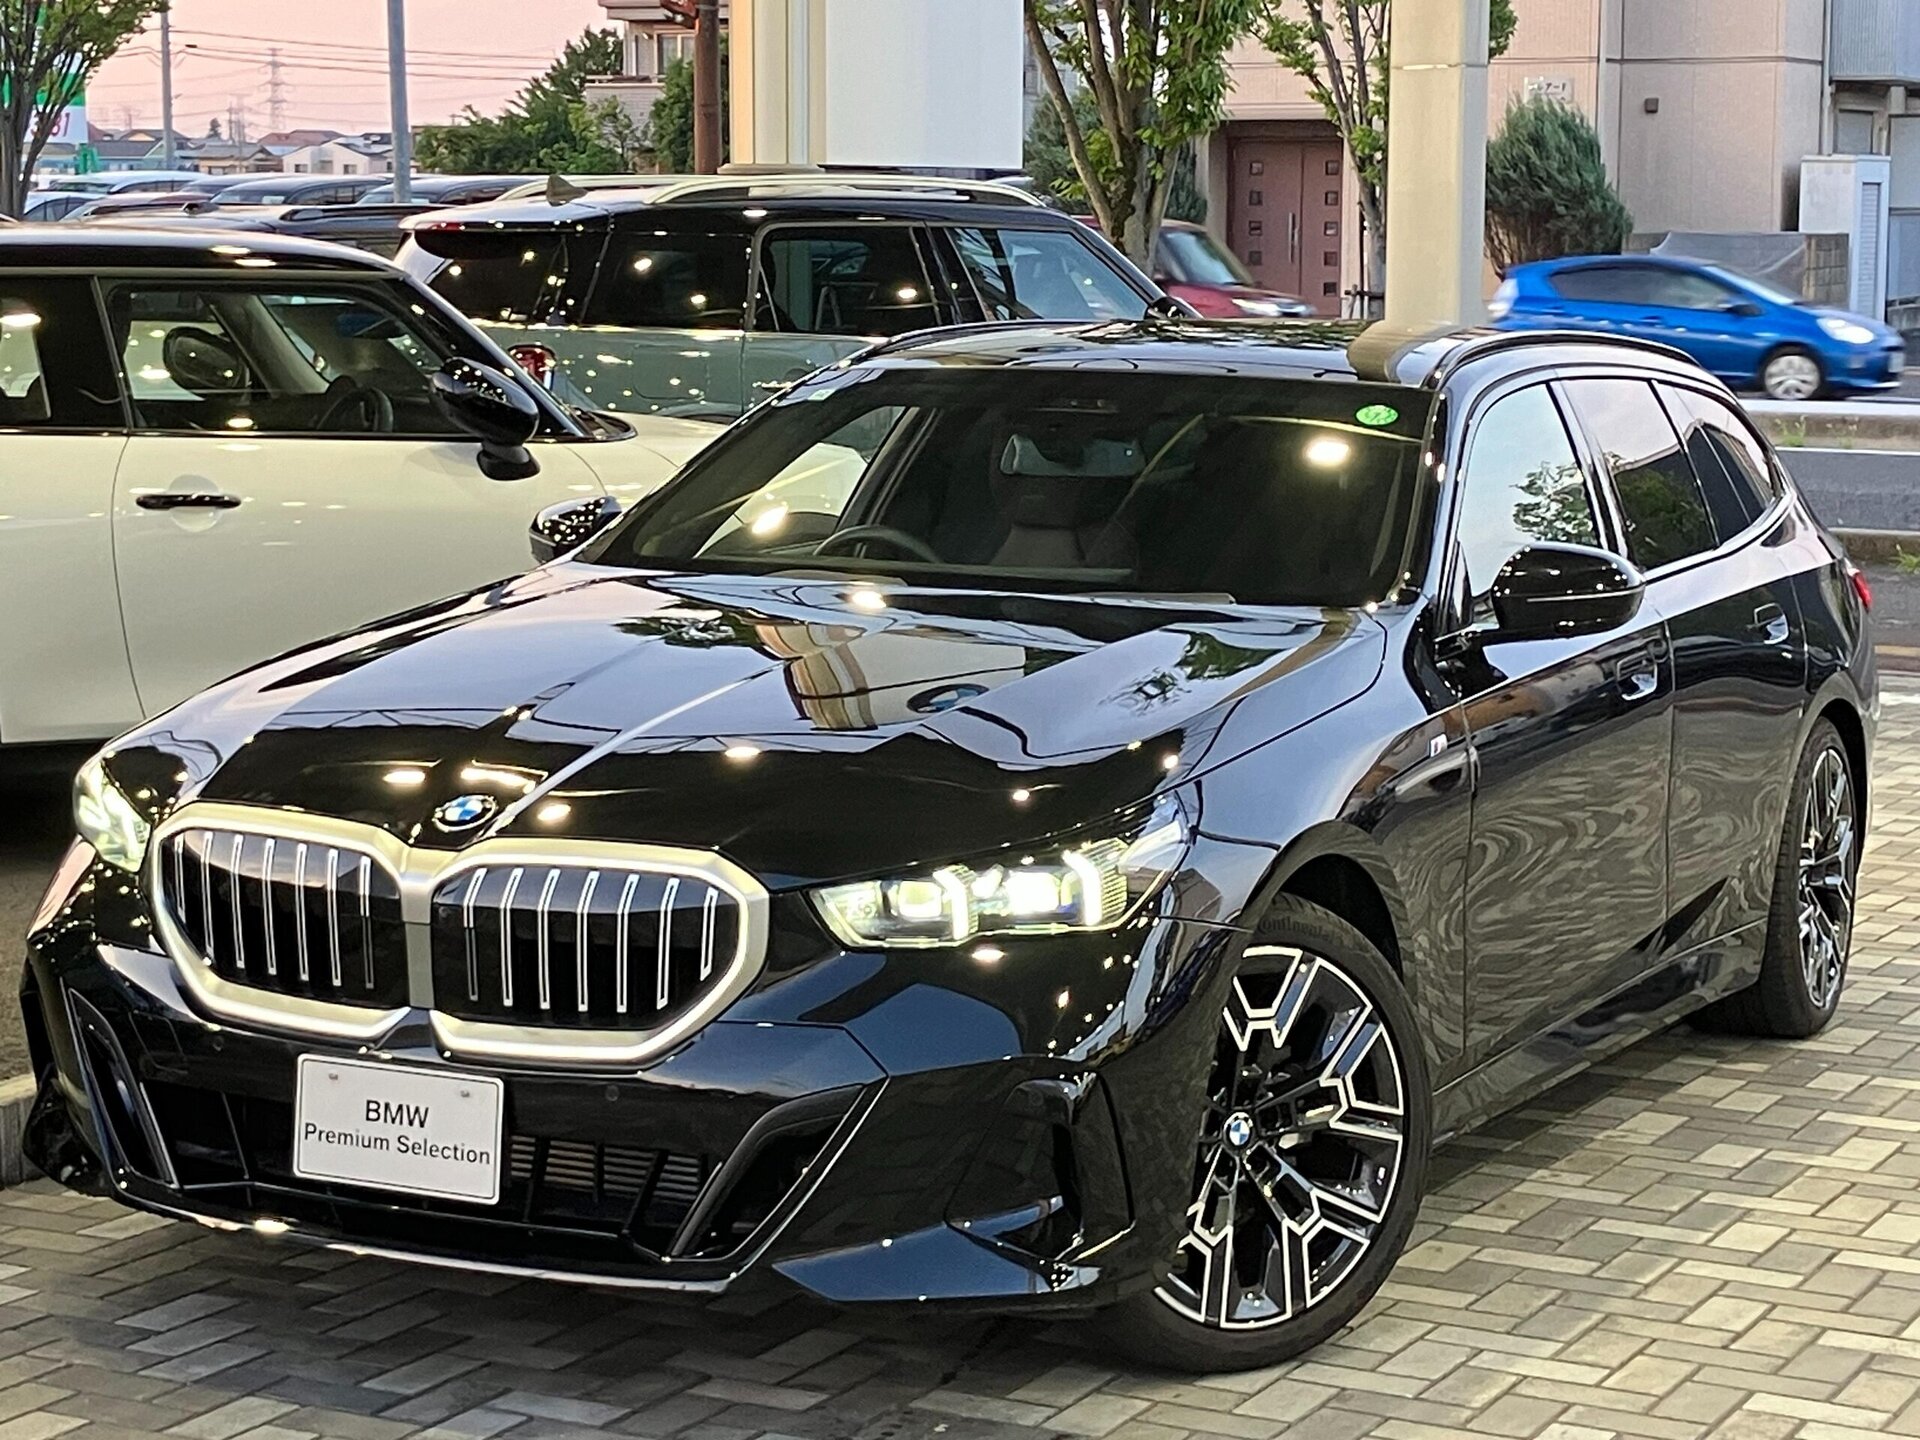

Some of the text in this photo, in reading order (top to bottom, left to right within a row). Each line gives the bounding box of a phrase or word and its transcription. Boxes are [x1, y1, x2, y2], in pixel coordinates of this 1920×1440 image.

[365, 1099, 429, 1129] BMW
[304, 1122, 490, 1165] Premium Selection
